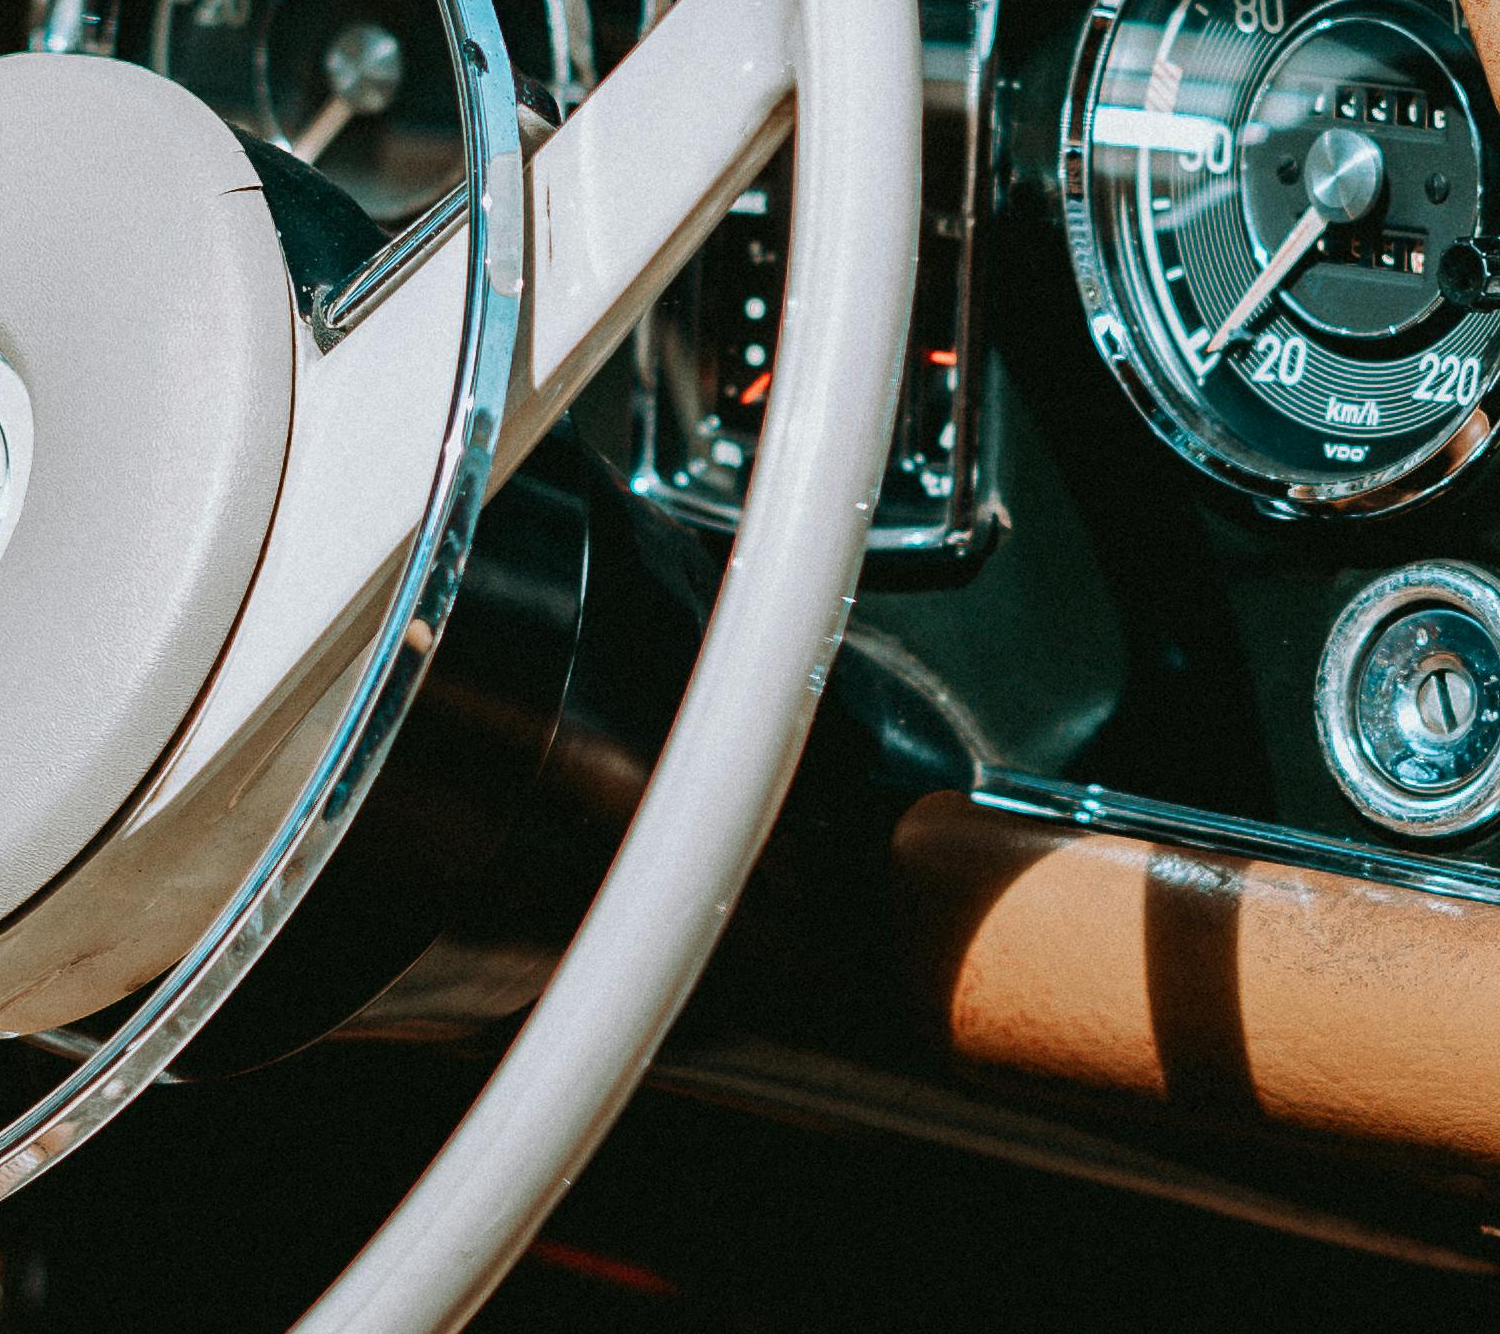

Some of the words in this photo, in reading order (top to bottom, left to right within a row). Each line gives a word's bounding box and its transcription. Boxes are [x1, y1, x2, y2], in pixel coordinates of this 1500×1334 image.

[1251, 334, 1307, 386] 20
[1412, 352, 1480, 406] 220
[1325, 397, 1380, 426] km/h
[1324, 442, 1368, 463] VDO
